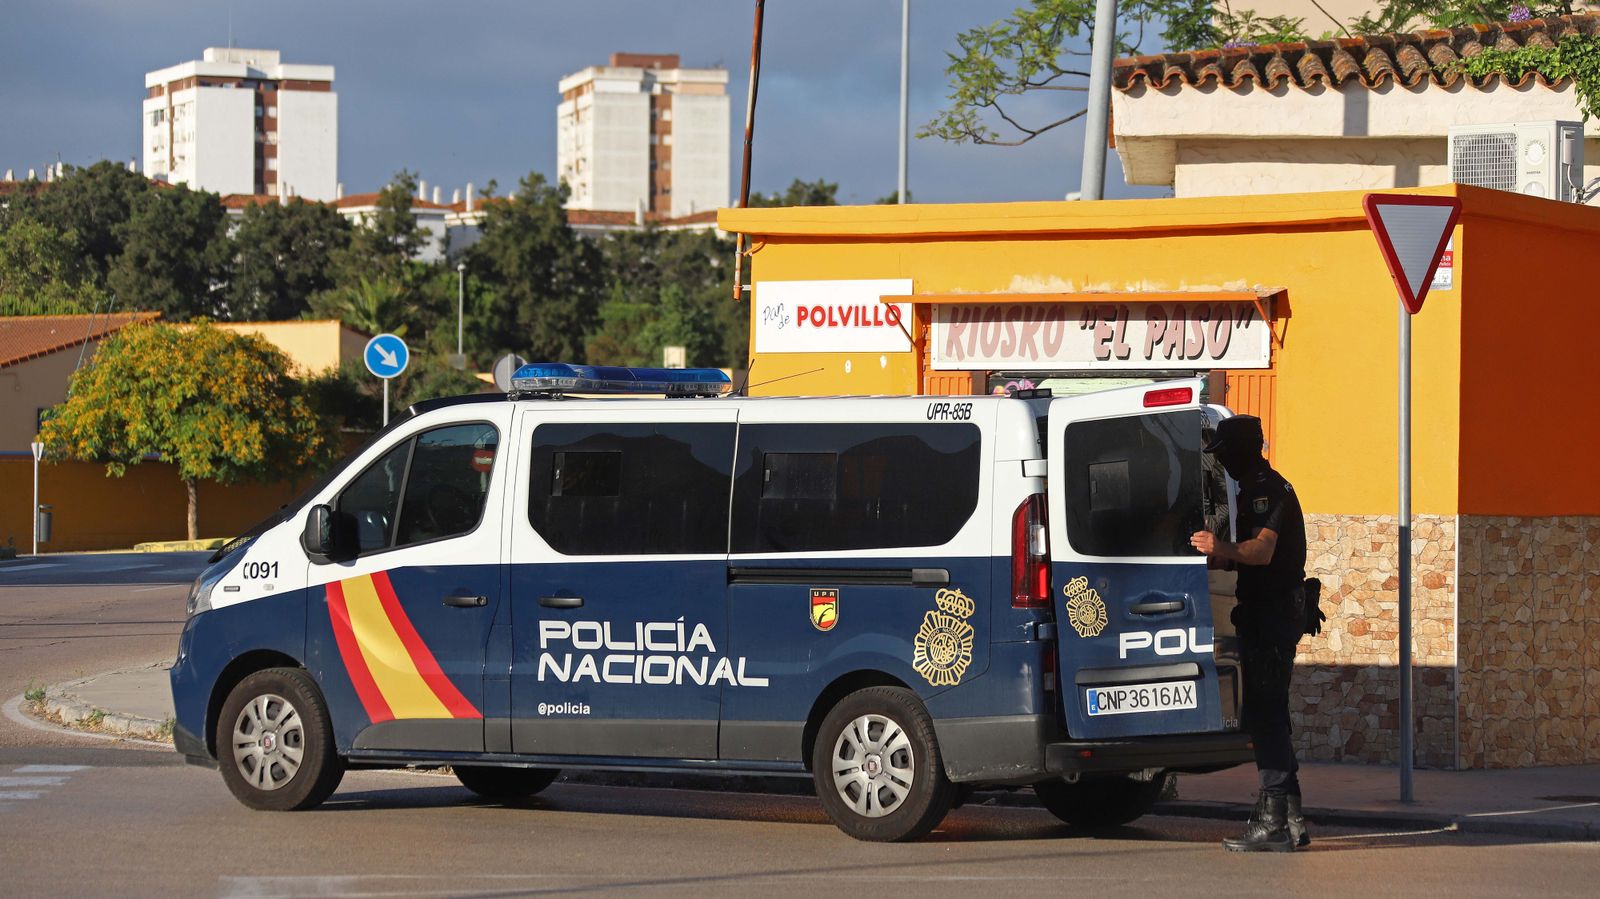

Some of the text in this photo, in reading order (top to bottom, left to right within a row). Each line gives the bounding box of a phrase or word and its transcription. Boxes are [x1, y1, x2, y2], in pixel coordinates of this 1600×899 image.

[763, 303, 785, 325] Pan
[778, 314, 790, 330] de
[797, 304, 902, 328] POLVILLO
[945, 302, 1255, 362] KIOSKO "EL PASO"
[926, 402, 973, 421] UPR-85B
[249, 560, 279, 580] 091
[538, 615, 717, 653] POLICÍA
[1119, 626, 1215, 659] POL
[537, 652, 770, 687] NACIONAL
[537, 702, 591, 716] @policia
